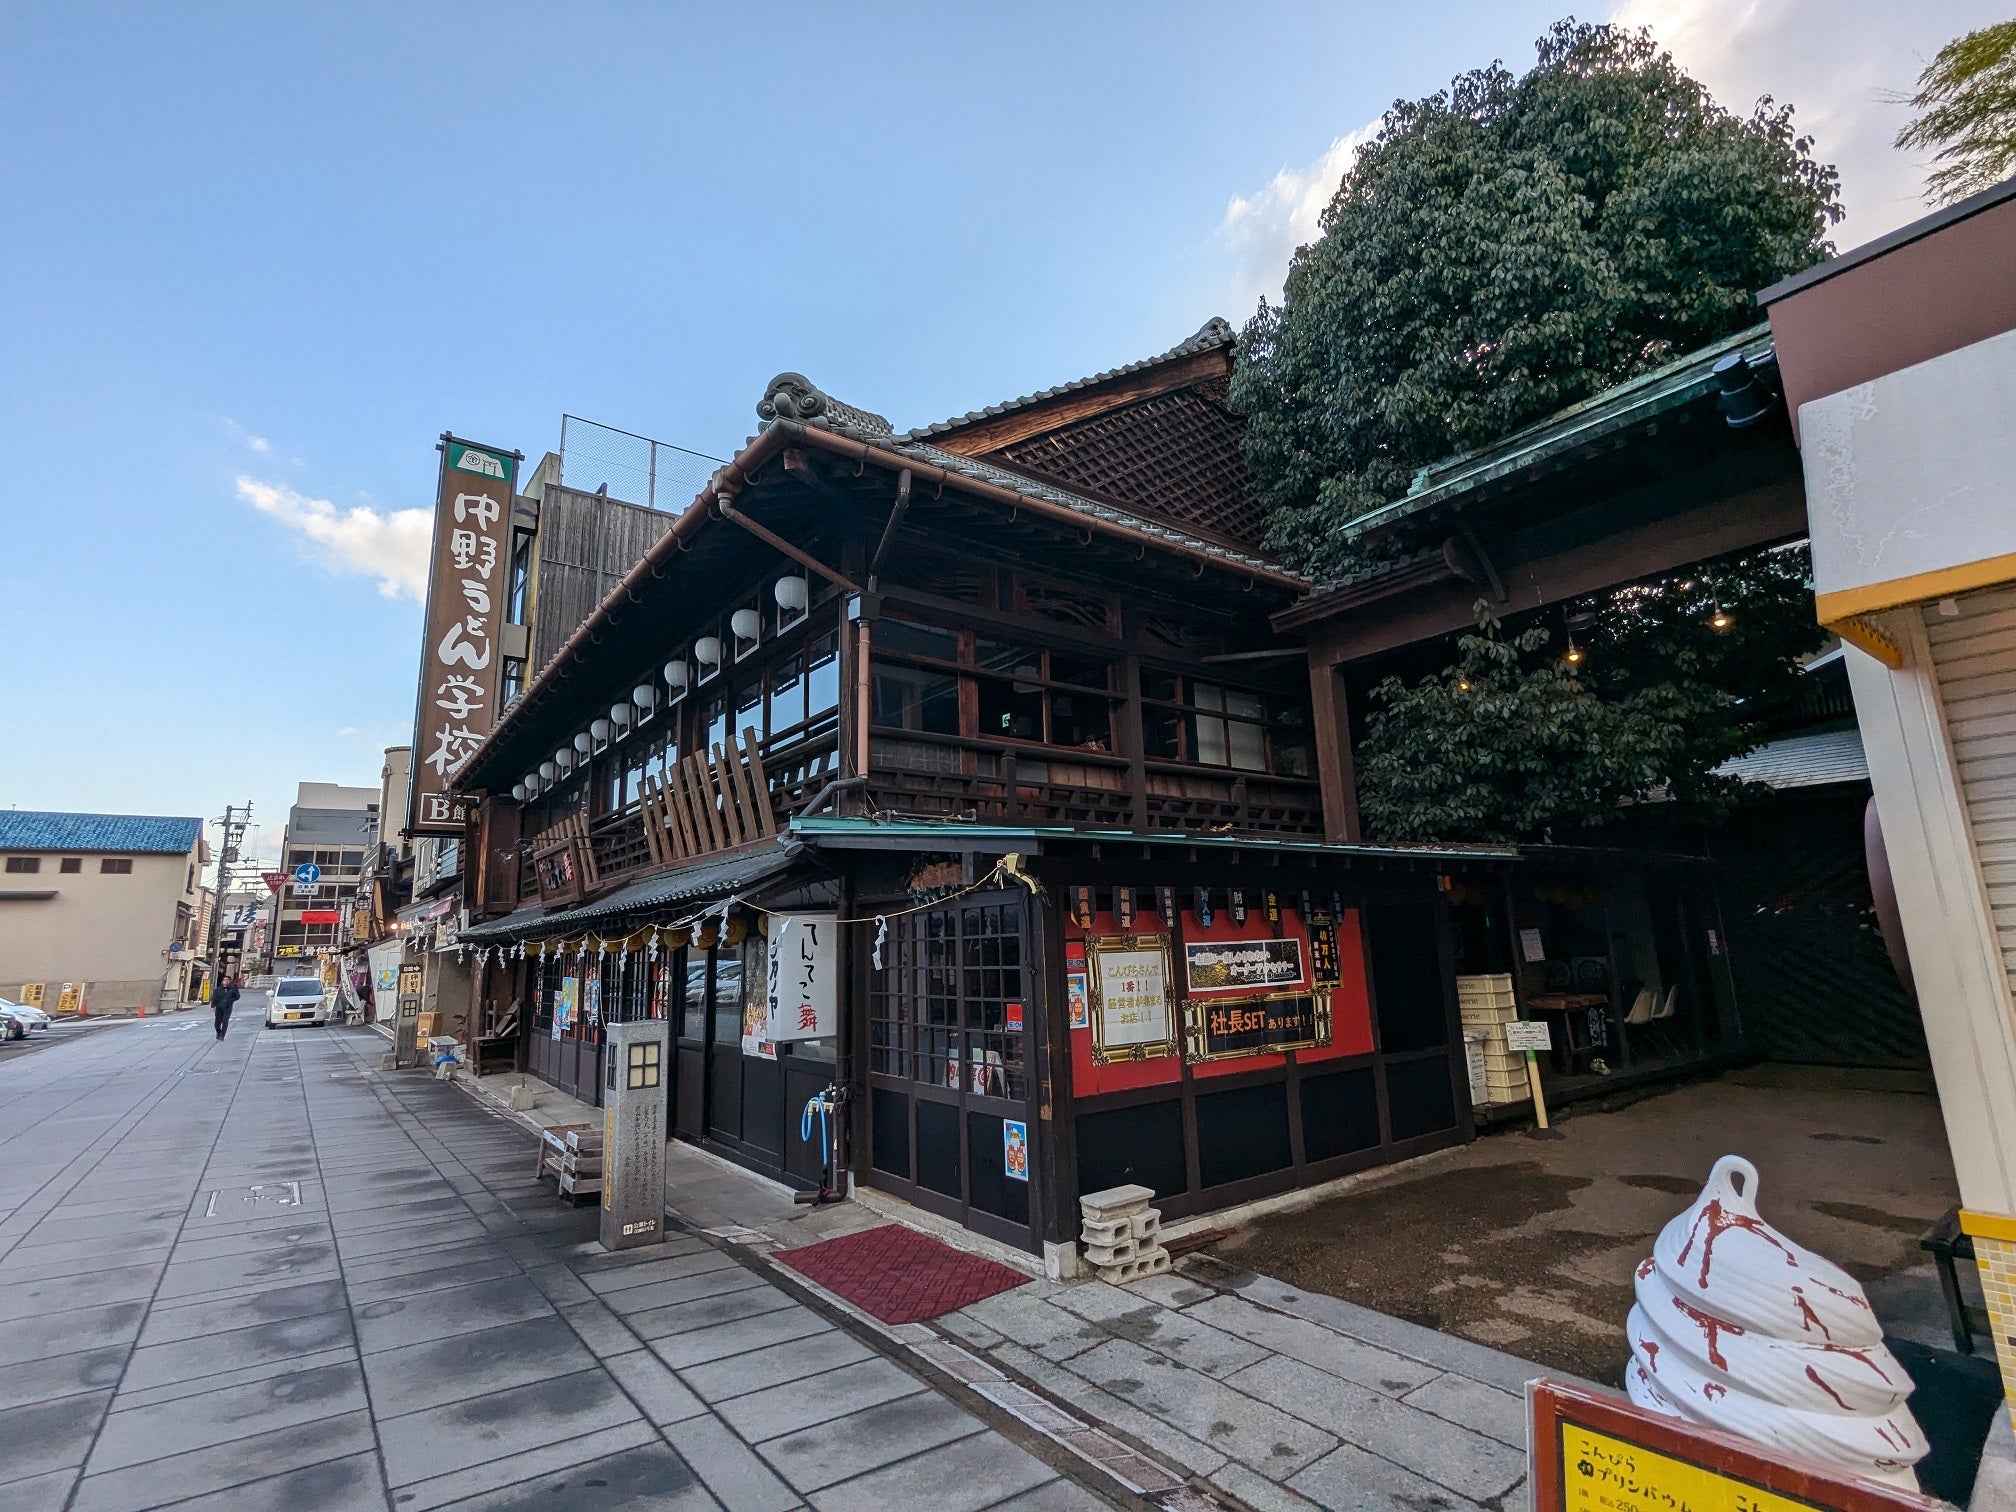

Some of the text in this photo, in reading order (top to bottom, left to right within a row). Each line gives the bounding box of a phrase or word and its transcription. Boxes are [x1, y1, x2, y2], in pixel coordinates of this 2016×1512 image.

[424, 492, 500, 776] 中野うどん学校
[1233, 890, 1245, 921] 財運
[1267, 891, 1279, 922] 金運
[797, 923, 818, 1033] てんてこ舞
[1107, 964, 1159, 978] こんぴらさんで
[1107, 994, 1163, 1010] 経営者が集まる
[1580, 1440, 1636, 1473] こんぴら
